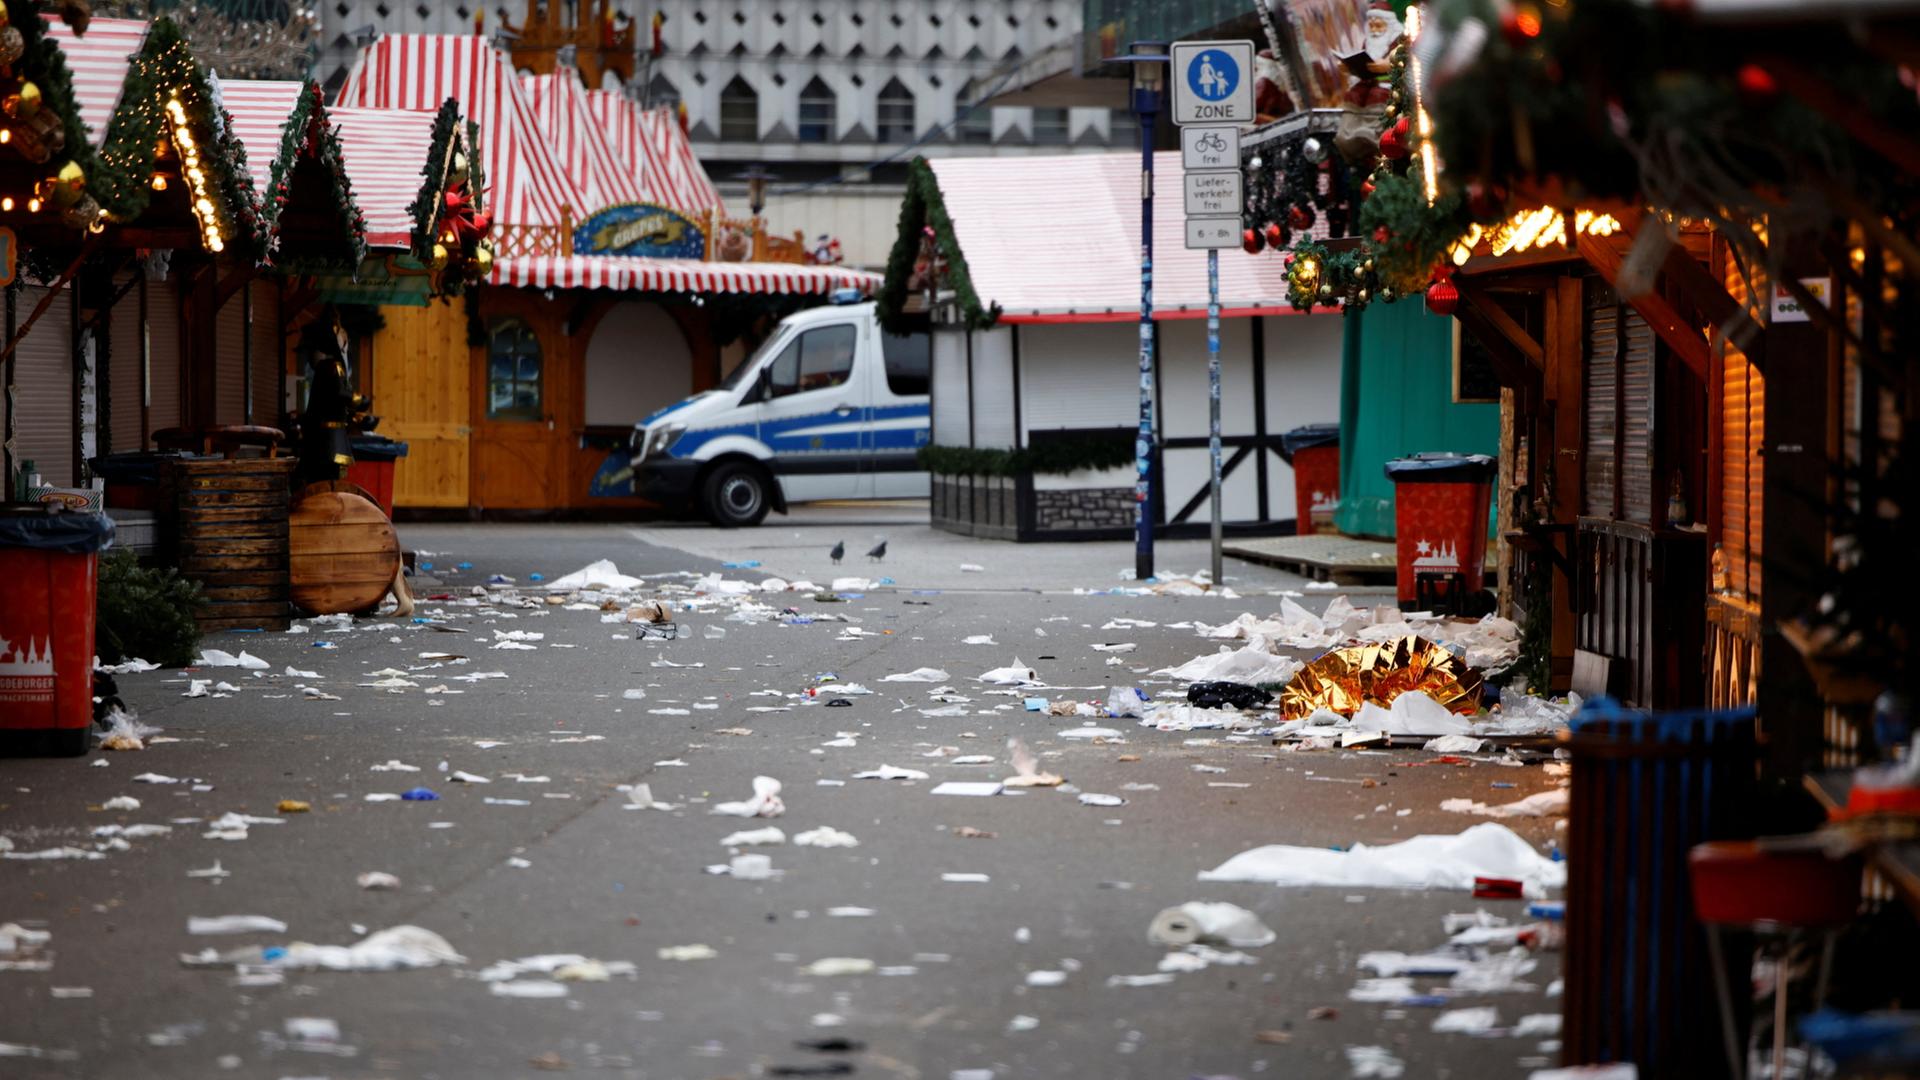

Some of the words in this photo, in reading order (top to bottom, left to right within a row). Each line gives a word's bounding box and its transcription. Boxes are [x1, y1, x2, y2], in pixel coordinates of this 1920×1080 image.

[1194, 104, 1235, 119] ZONE
[1202, 154, 1222, 164] frei
[1194, 177, 1231, 188] Liefer-
[1193, 189, 1234, 199] verkehr
[1203, 200, 1222, 210] frei
